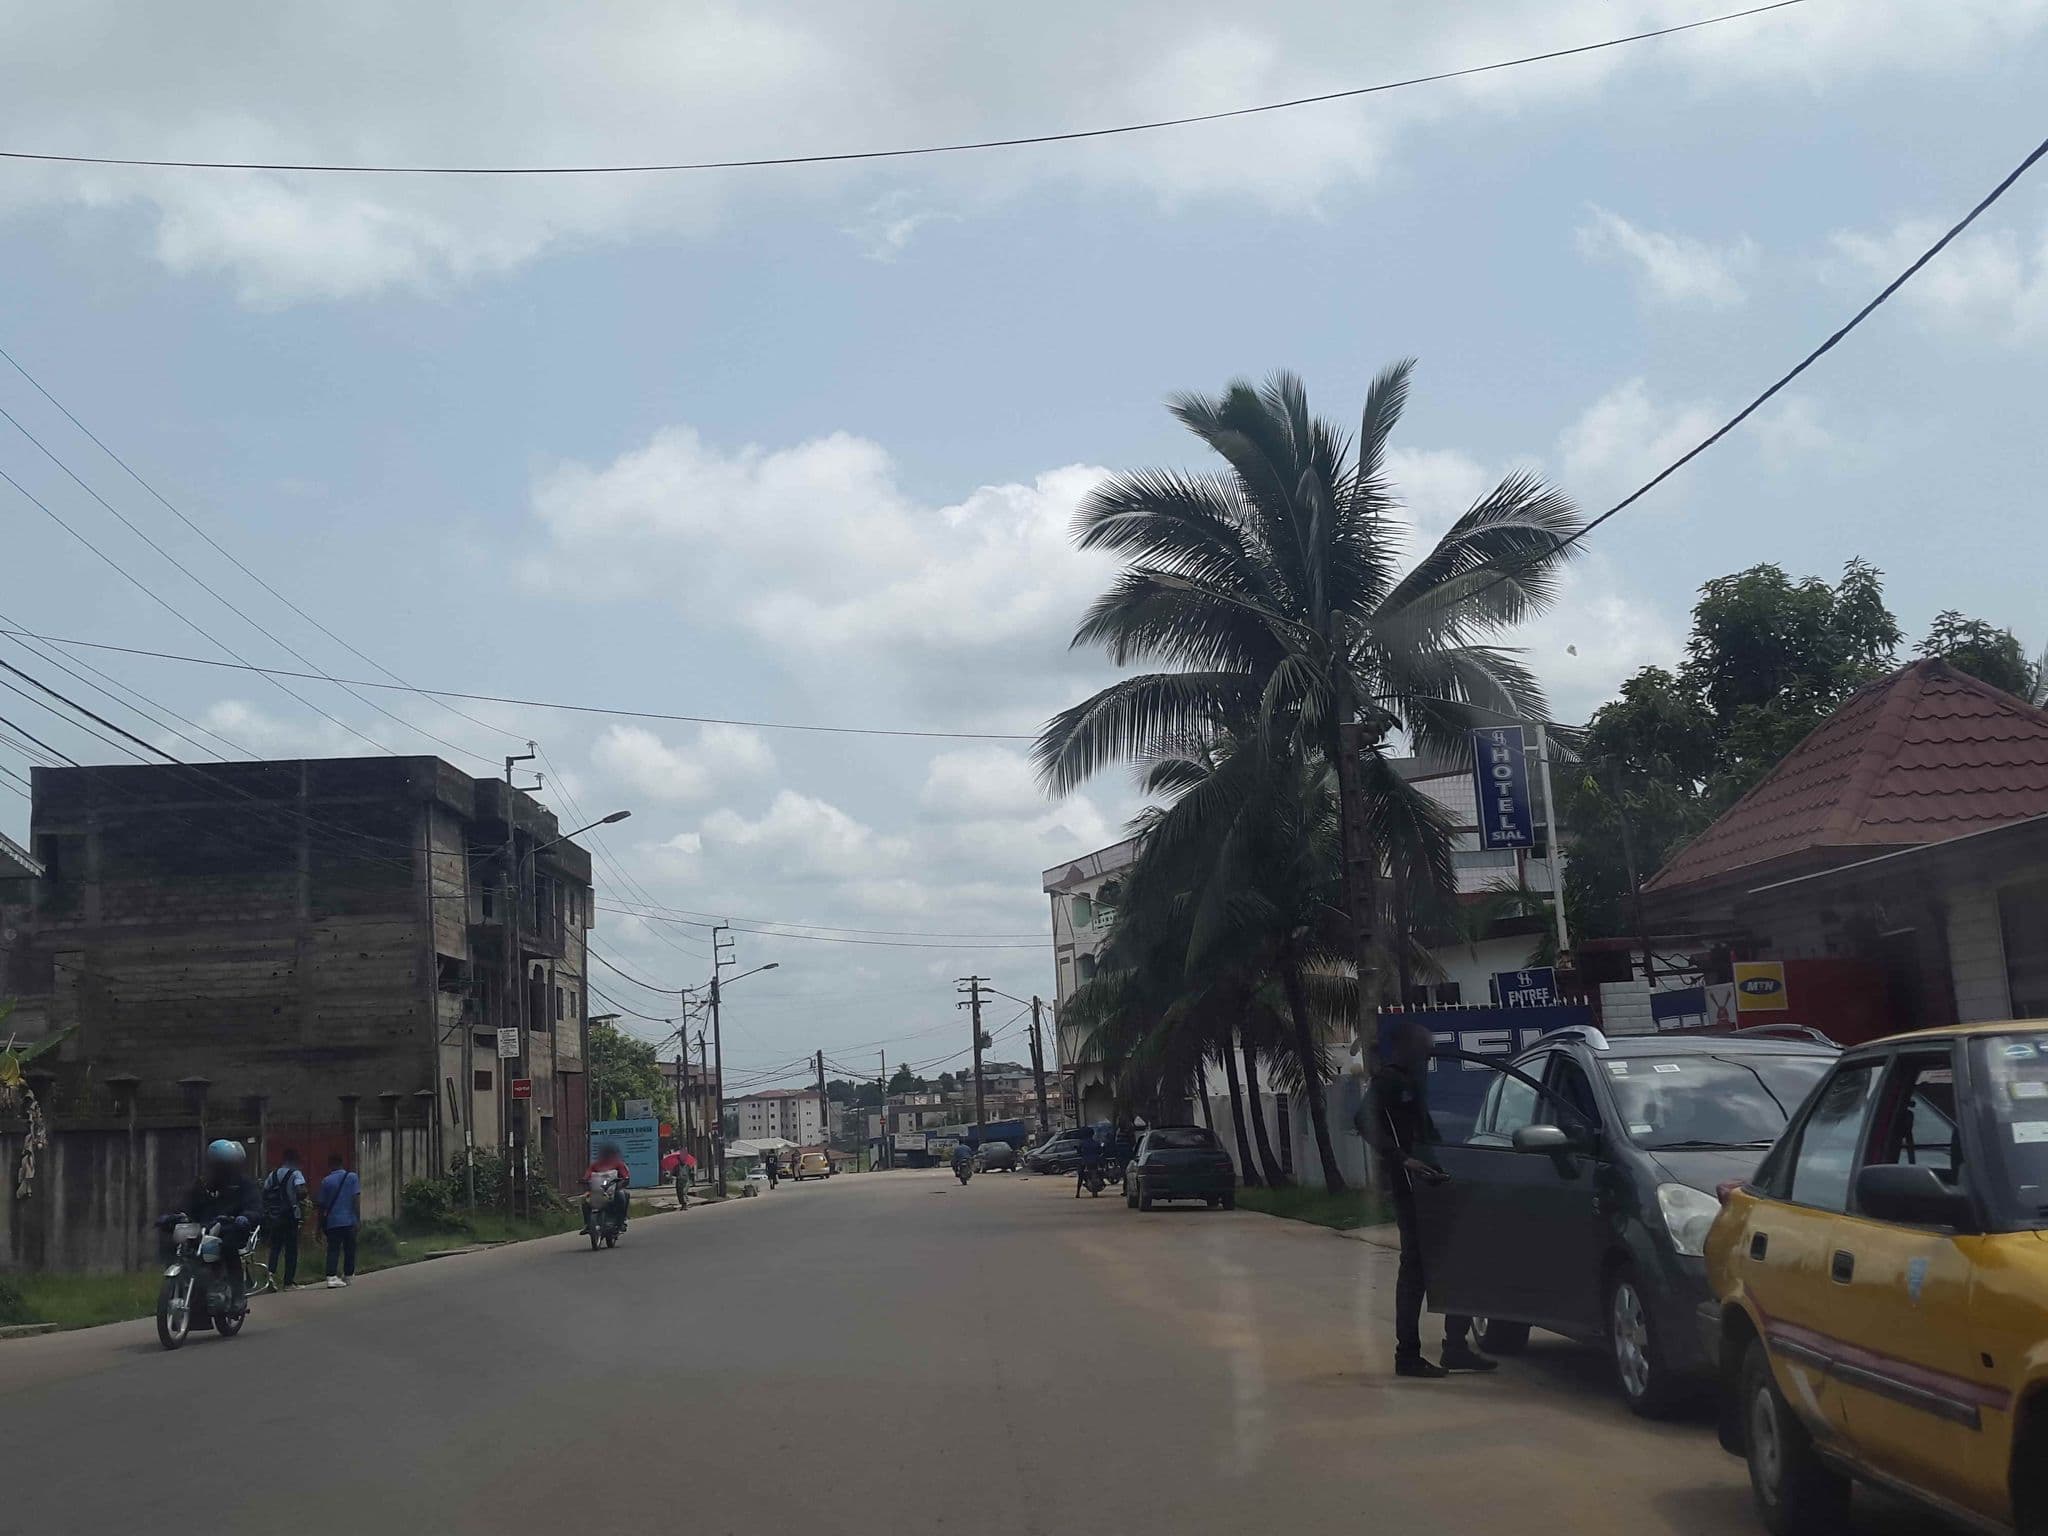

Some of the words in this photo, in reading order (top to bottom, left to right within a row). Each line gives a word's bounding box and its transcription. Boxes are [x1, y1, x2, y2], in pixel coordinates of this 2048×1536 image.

[1491, 748, 1517, 831] HOTEL
[1491, 831, 1527, 841] SIAL
[1745, 980, 1775, 992] MTN
[1508, 987, 1551, 1003] ENTREE
